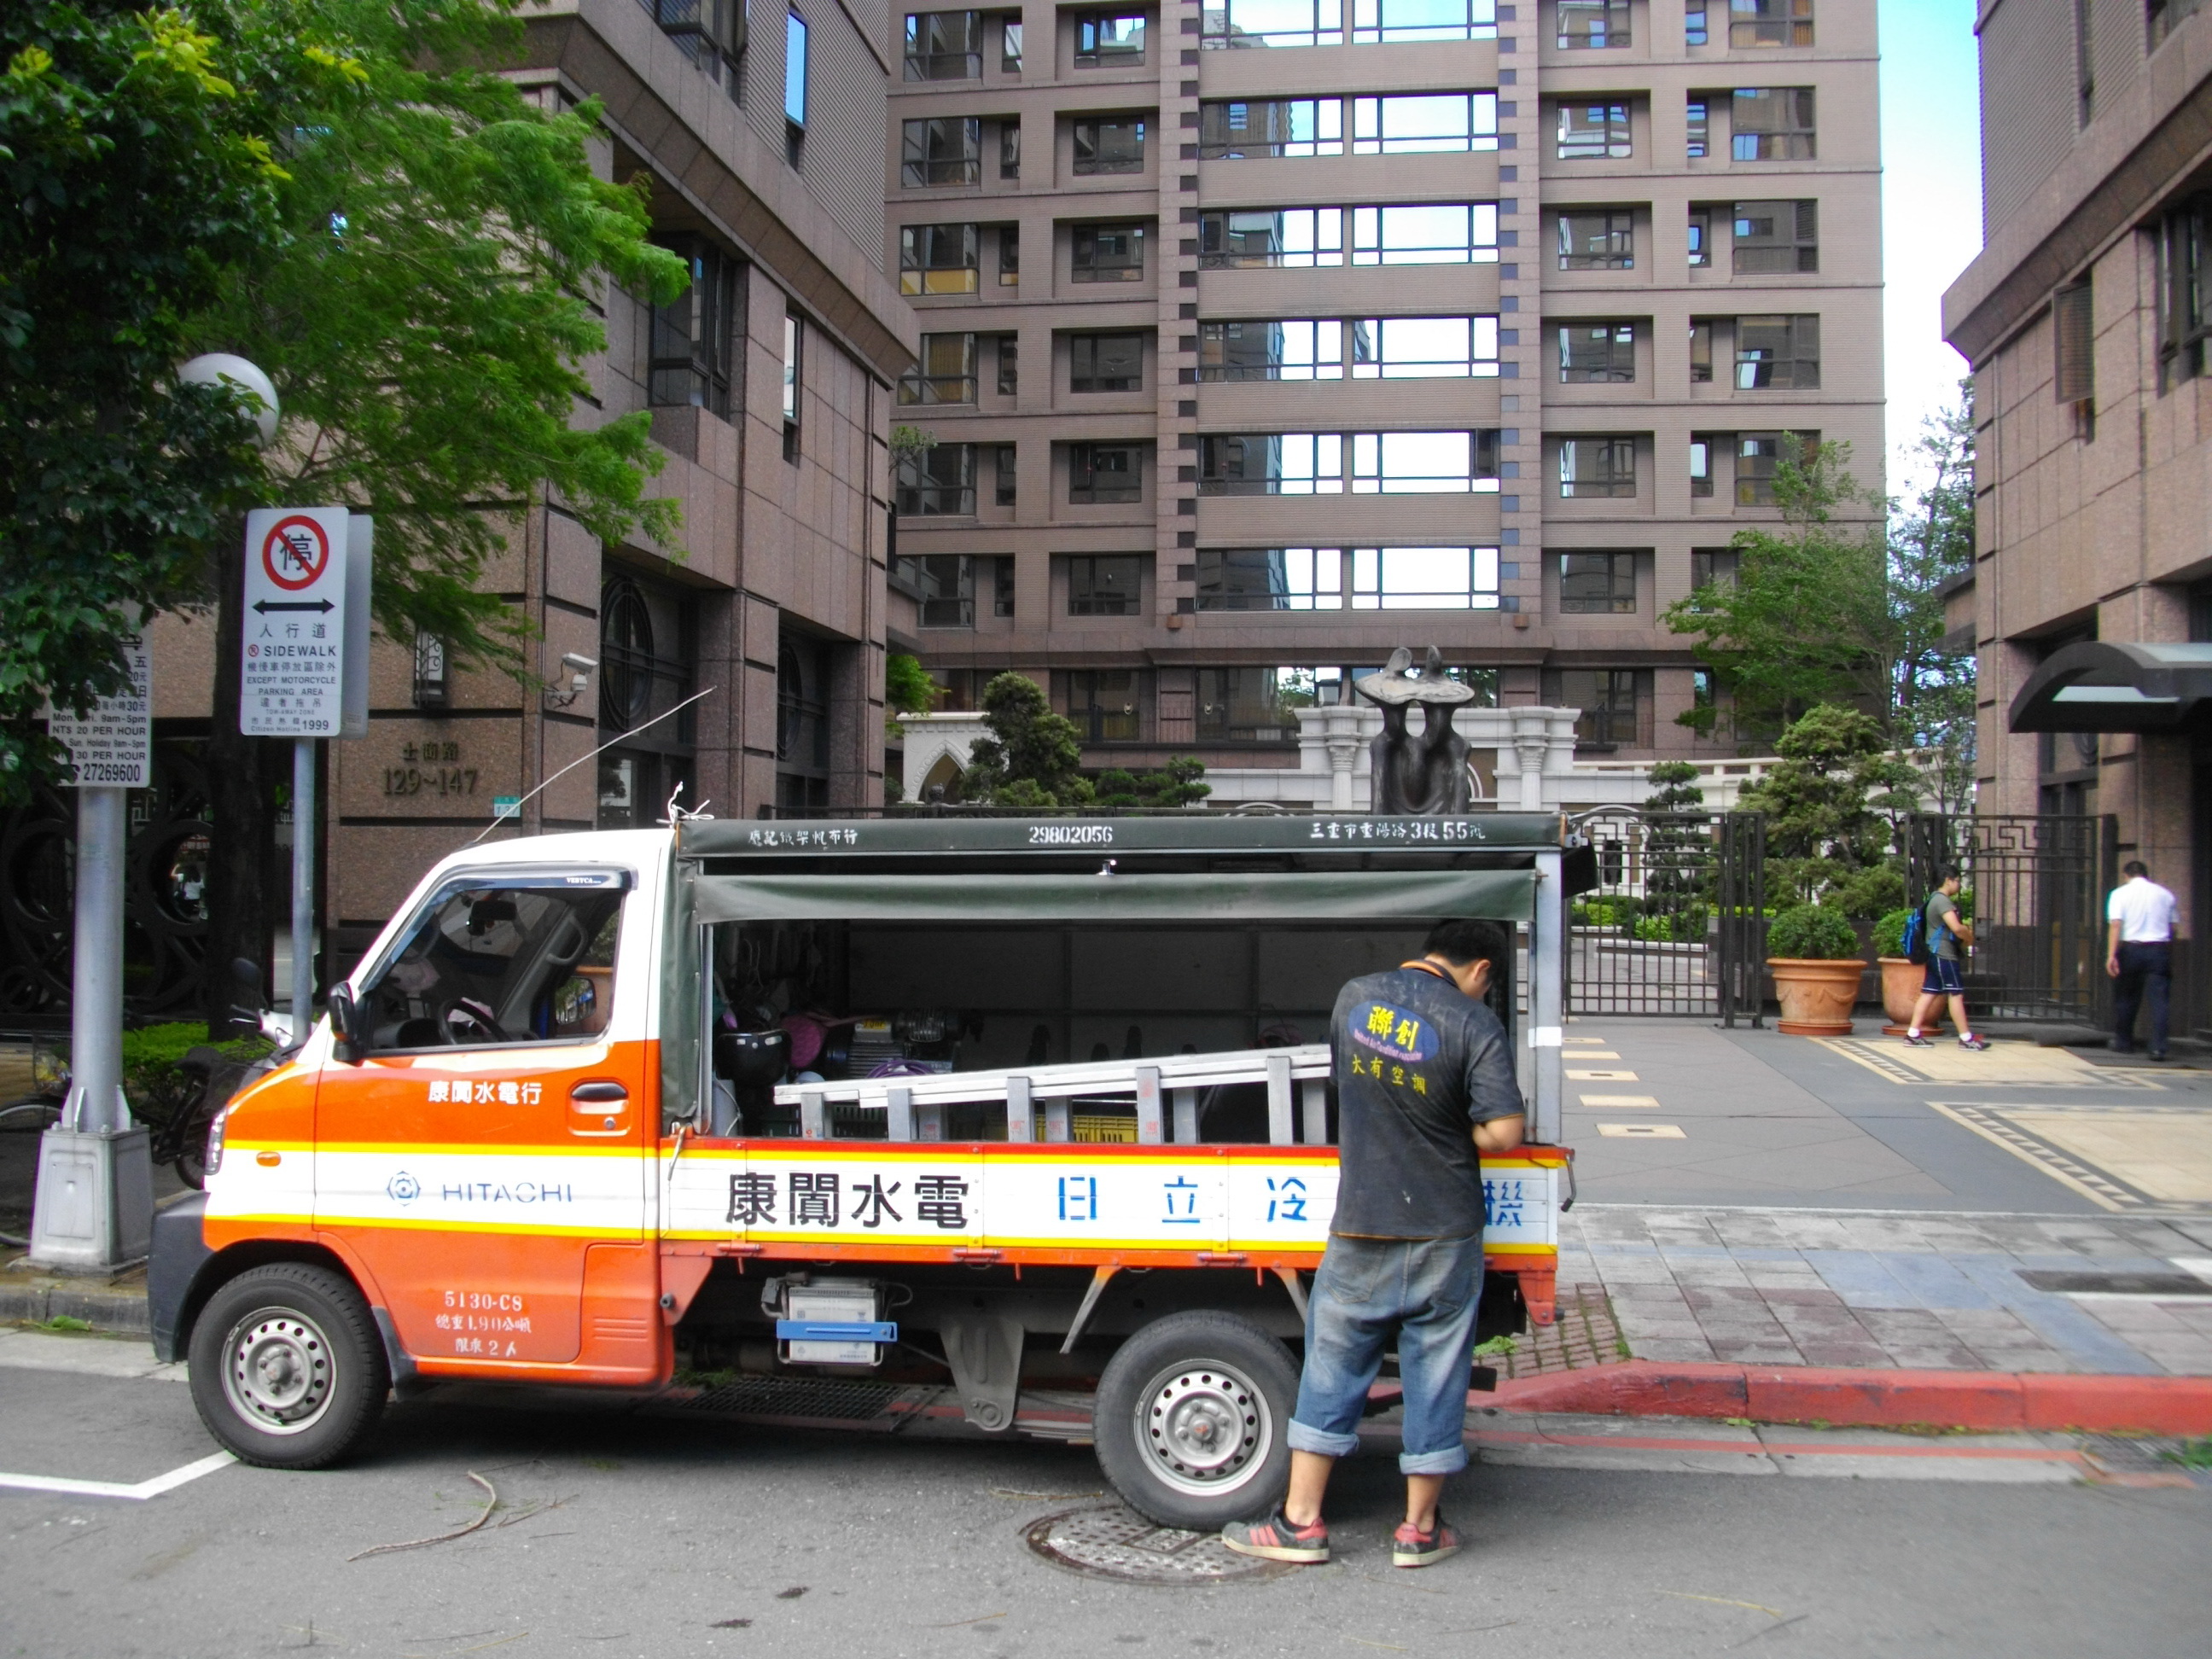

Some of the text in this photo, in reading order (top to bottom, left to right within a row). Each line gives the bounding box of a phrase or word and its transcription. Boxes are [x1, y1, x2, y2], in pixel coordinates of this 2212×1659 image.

[259, 623, 326, 638] 人行道
[264, 645, 336, 657] SIDEWALK
[77, 726, 88, 735] 20
[93, 726, 113, 735] PER
[302, 719, 329, 731] 1999
[87, 738, 111, 748] Holiday
[93, 751, 113, 760] PER
[117, 752, 146, 760] HOUR
[83, 763, 140, 782] 27269600
[1029, 826, 1113, 843] 29802056
[1367, 1005, 1419, 1051] 聯創
[442, 1182, 573, 1203] HITACHI
